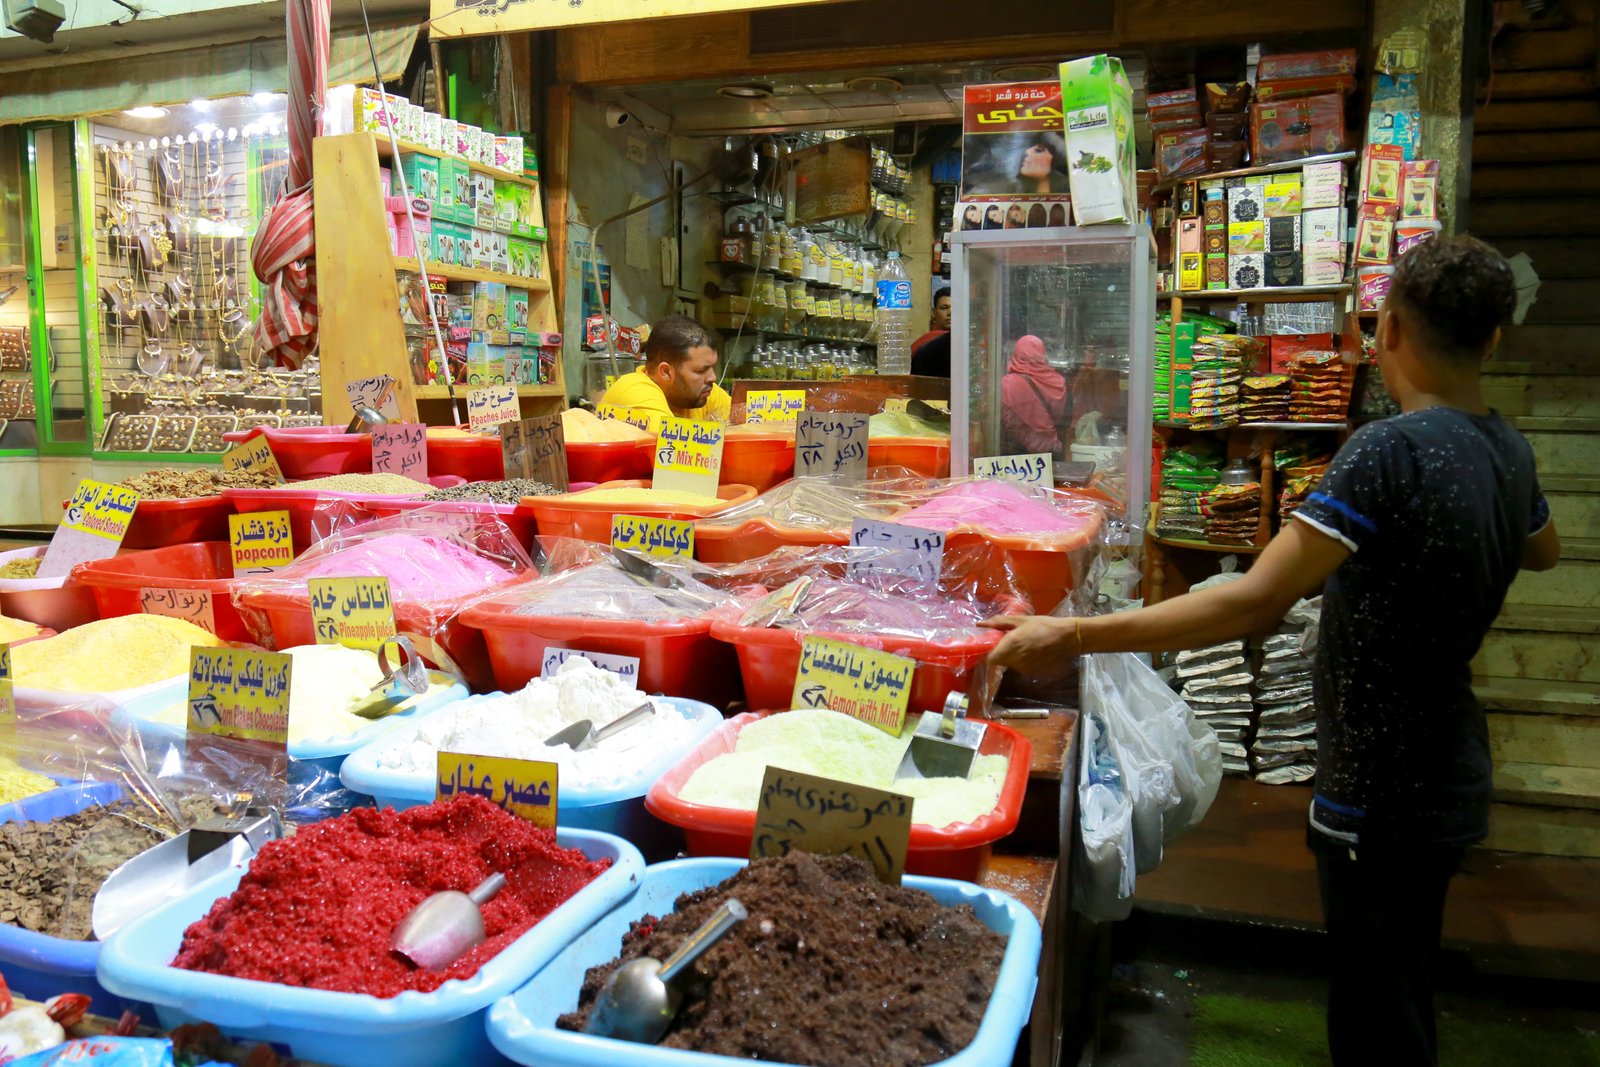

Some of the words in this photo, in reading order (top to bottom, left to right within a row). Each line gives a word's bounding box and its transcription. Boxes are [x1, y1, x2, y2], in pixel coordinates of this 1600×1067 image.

[995, 88, 1012, 102] شعر
[1015, 89, 1028, 101] فرد
[1030, 89, 1046, 99] حنة
[1090, 112, 1107, 121] Life
[469, 393, 487, 412] خام
[490, 387, 515, 409] خوخ
[782, 398, 803, 414] عصير
[471, 411, 499, 426] Peaches
[501, 407, 517, 420] Juice
[799, 416, 824, 439] خام
[823, 416, 867, 440] خروب
[660, 420, 690, 449] بانية
[692, 423, 722, 446] خلطة
[256, 445, 270, 465] دوم
[676, 450, 694, 467] Mix
[95, 487, 137, 514] فنكوش
[82, 511, 106, 531] Colored
[103, 516, 125, 537] Snacks
[234, 519, 266, 547] فشار
[266, 516, 289, 544] ذرة
[612, 520, 635, 546] خام
[639, 522, 691, 555] كوكاكولا
[235, 546, 290, 565] popcorn
[141, 589, 166, 614] خام
[166, 589, 208, 617] برتقال
[312, 585, 337, 617] خام
[341, 581, 390, 617] أناناس
[339, 621, 374, 641] Pineapple
[375, 621, 394, 642] juice
[800, 642, 863, 690] بالنعناع
[265, 663, 288, 698] كورن
[863, 660, 909, 698] ليمون
[827, 688, 859, 719] Lemon
[859, 697, 878, 722] with
[879, 702, 901, 729] Mint
[438, 762, 494, 802] عناب
[500, 776, 551, 817] عصير
